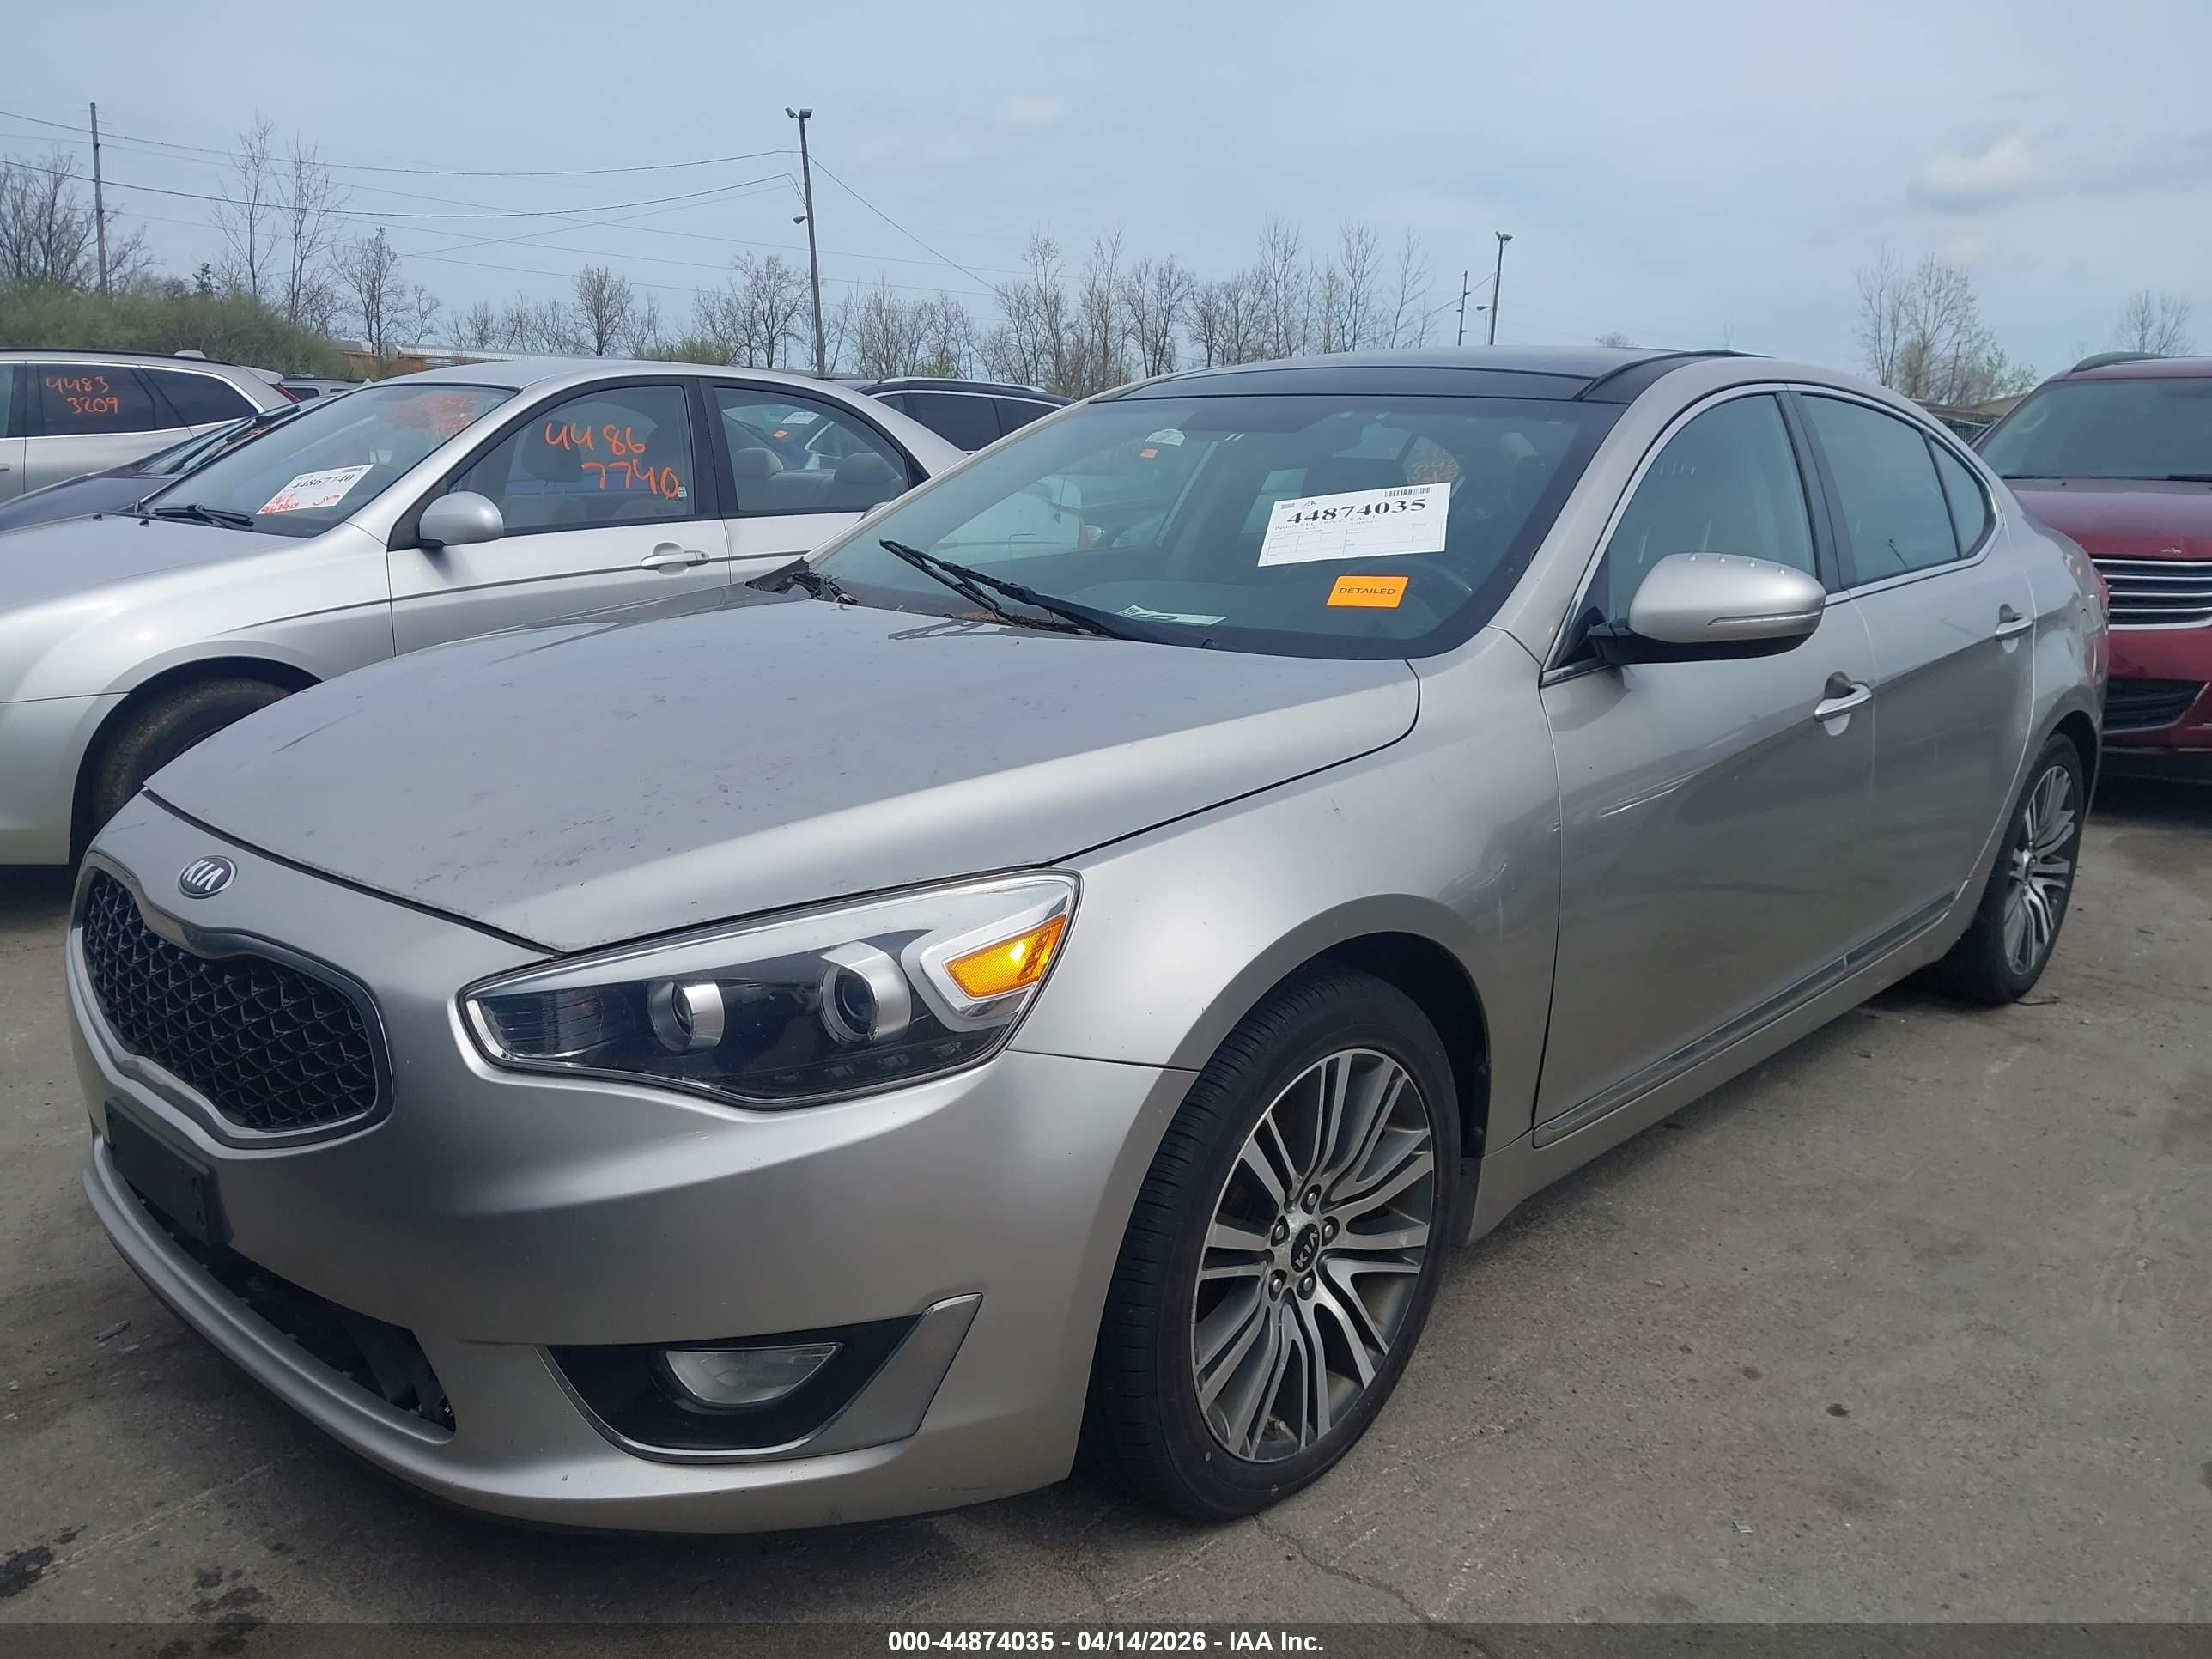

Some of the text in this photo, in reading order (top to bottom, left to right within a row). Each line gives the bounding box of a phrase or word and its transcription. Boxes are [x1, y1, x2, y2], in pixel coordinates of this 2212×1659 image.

[46, 375, 110, 393] 4483
[65, 396, 119, 414] 3209
[544, 422, 647, 455] 4486
[580, 458, 679, 500] 7740
[1286, 498, 1427, 524] 44874035
[1339, 587, 1397, 596] DETAILED
[181, 860, 225, 892] KIA
[1295, 1231, 1318, 1268] KIA
